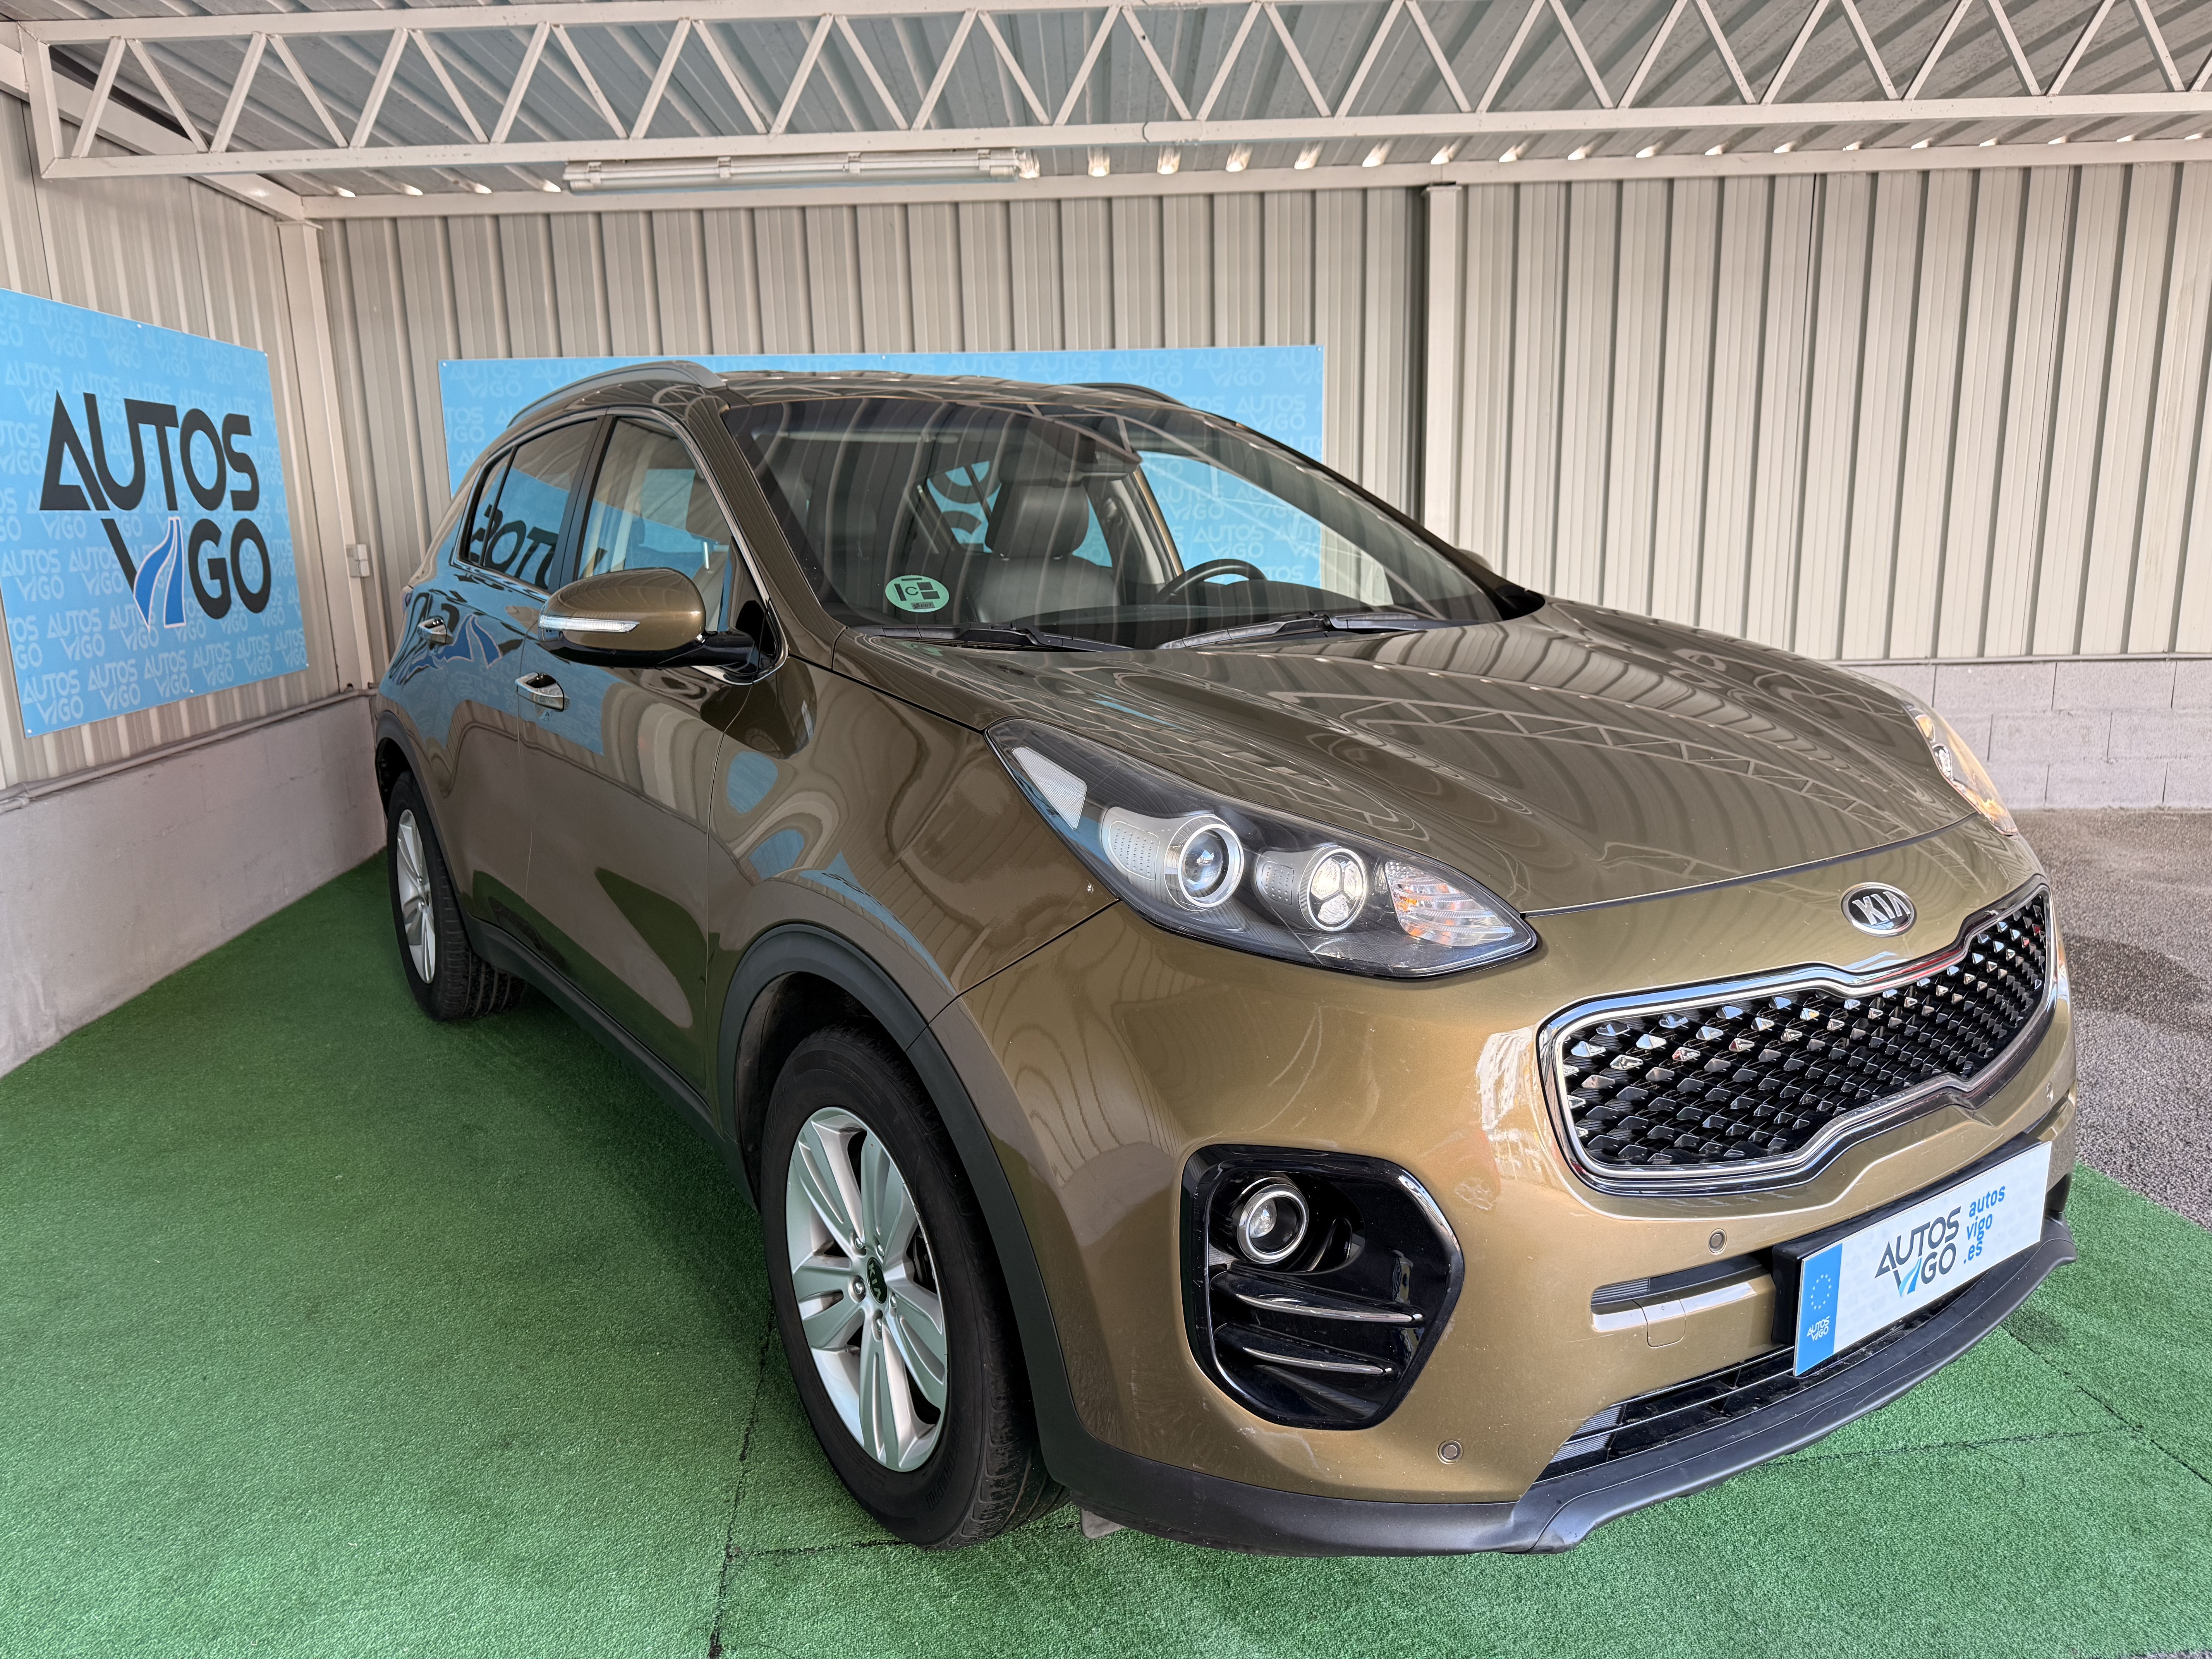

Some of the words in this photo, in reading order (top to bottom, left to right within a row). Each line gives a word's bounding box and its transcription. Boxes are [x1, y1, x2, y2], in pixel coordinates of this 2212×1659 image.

[29, 301, 84, 335] AUTOS
[91, 316, 138, 346] AUTOS
[40, 327, 88, 360] VIGO
[102, 340, 141, 369] VIGO
[156, 352, 191, 379] VIGO
[448, 361, 521, 380] AUTOS
[1029, 353, 1101, 372] AUTOS
[1110, 351, 1183, 371] AUTOS
[1193, 351, 1266, 369] AUTOS
[4, 359, 64, 395] AUTOS
[465, 376, 522, 398] VIGO
[1125, 369, 1183, 388] VIGO
[1207, 368, 1265, 387] VIGO
[19, 388, 54, 418] VIG
[1234, 394, 1306, 414] AUTOS
[1248, 410, 1306, 431] VIGO
[40, 390, 259, 511] AUTOS
[1166, 503, 1224, 520] VIGO
[39, 513, 87, 540] VIGO
[1193, 525, 1265, 543] AUTOS
[2, 549, 61, 577] AUTOS
[69, 546, 120, 572] AUTOS
[1207, 542, 1265, 558] VIGO
[14, 575, 65, 601] VIGO
[81, 571, 123, 595] VIGO
[100, 517, 271, 633] VIGO
[905, 586, 919, 596] C
[47, 608, 102, 638] AUTOS
[220, 612, 248, 634] VIGO
[259, 606, 285, 628] VIGO
[59, 634, 105, 660] VIGO
[120, 626, 159, 651] VIGO
[236, 634, 270, 659] AUTOS
[275, 628, 304, 651] AUTOS
[144, 650, 187, 678] AUTOS
[193, 641, 232, 668] AUTOS
[244, 654, 273, 675] VIGO
[282, 647, 306, 667] VIGO
[23, 670, 81, 704] AUTOS
[88, 659, 138, 691] AUTOS
[156, 672, 190, 697] VIGO
[201, 663, 234, 686] VIGO
[100, 683, 141, 710] VIGO
[37, 695, 84, 725] VIGO
[1852, 891, 1911, 925] KIA
[1969, 1186, 2005, 1218] autos
[1966, 1214, 1992, 1241] vigo
[1875, 1206, 1961, 1279] AUTOS
[1963, 1240, 1983, 1264] .es
[868, 1262, 881, 1300] KIA
[1893, 1242, 1956, 1297] VIGO
[1807, 1316, 1830, 1336] AUTOS
[1811, 1326, 1829, 1341] VIGO
